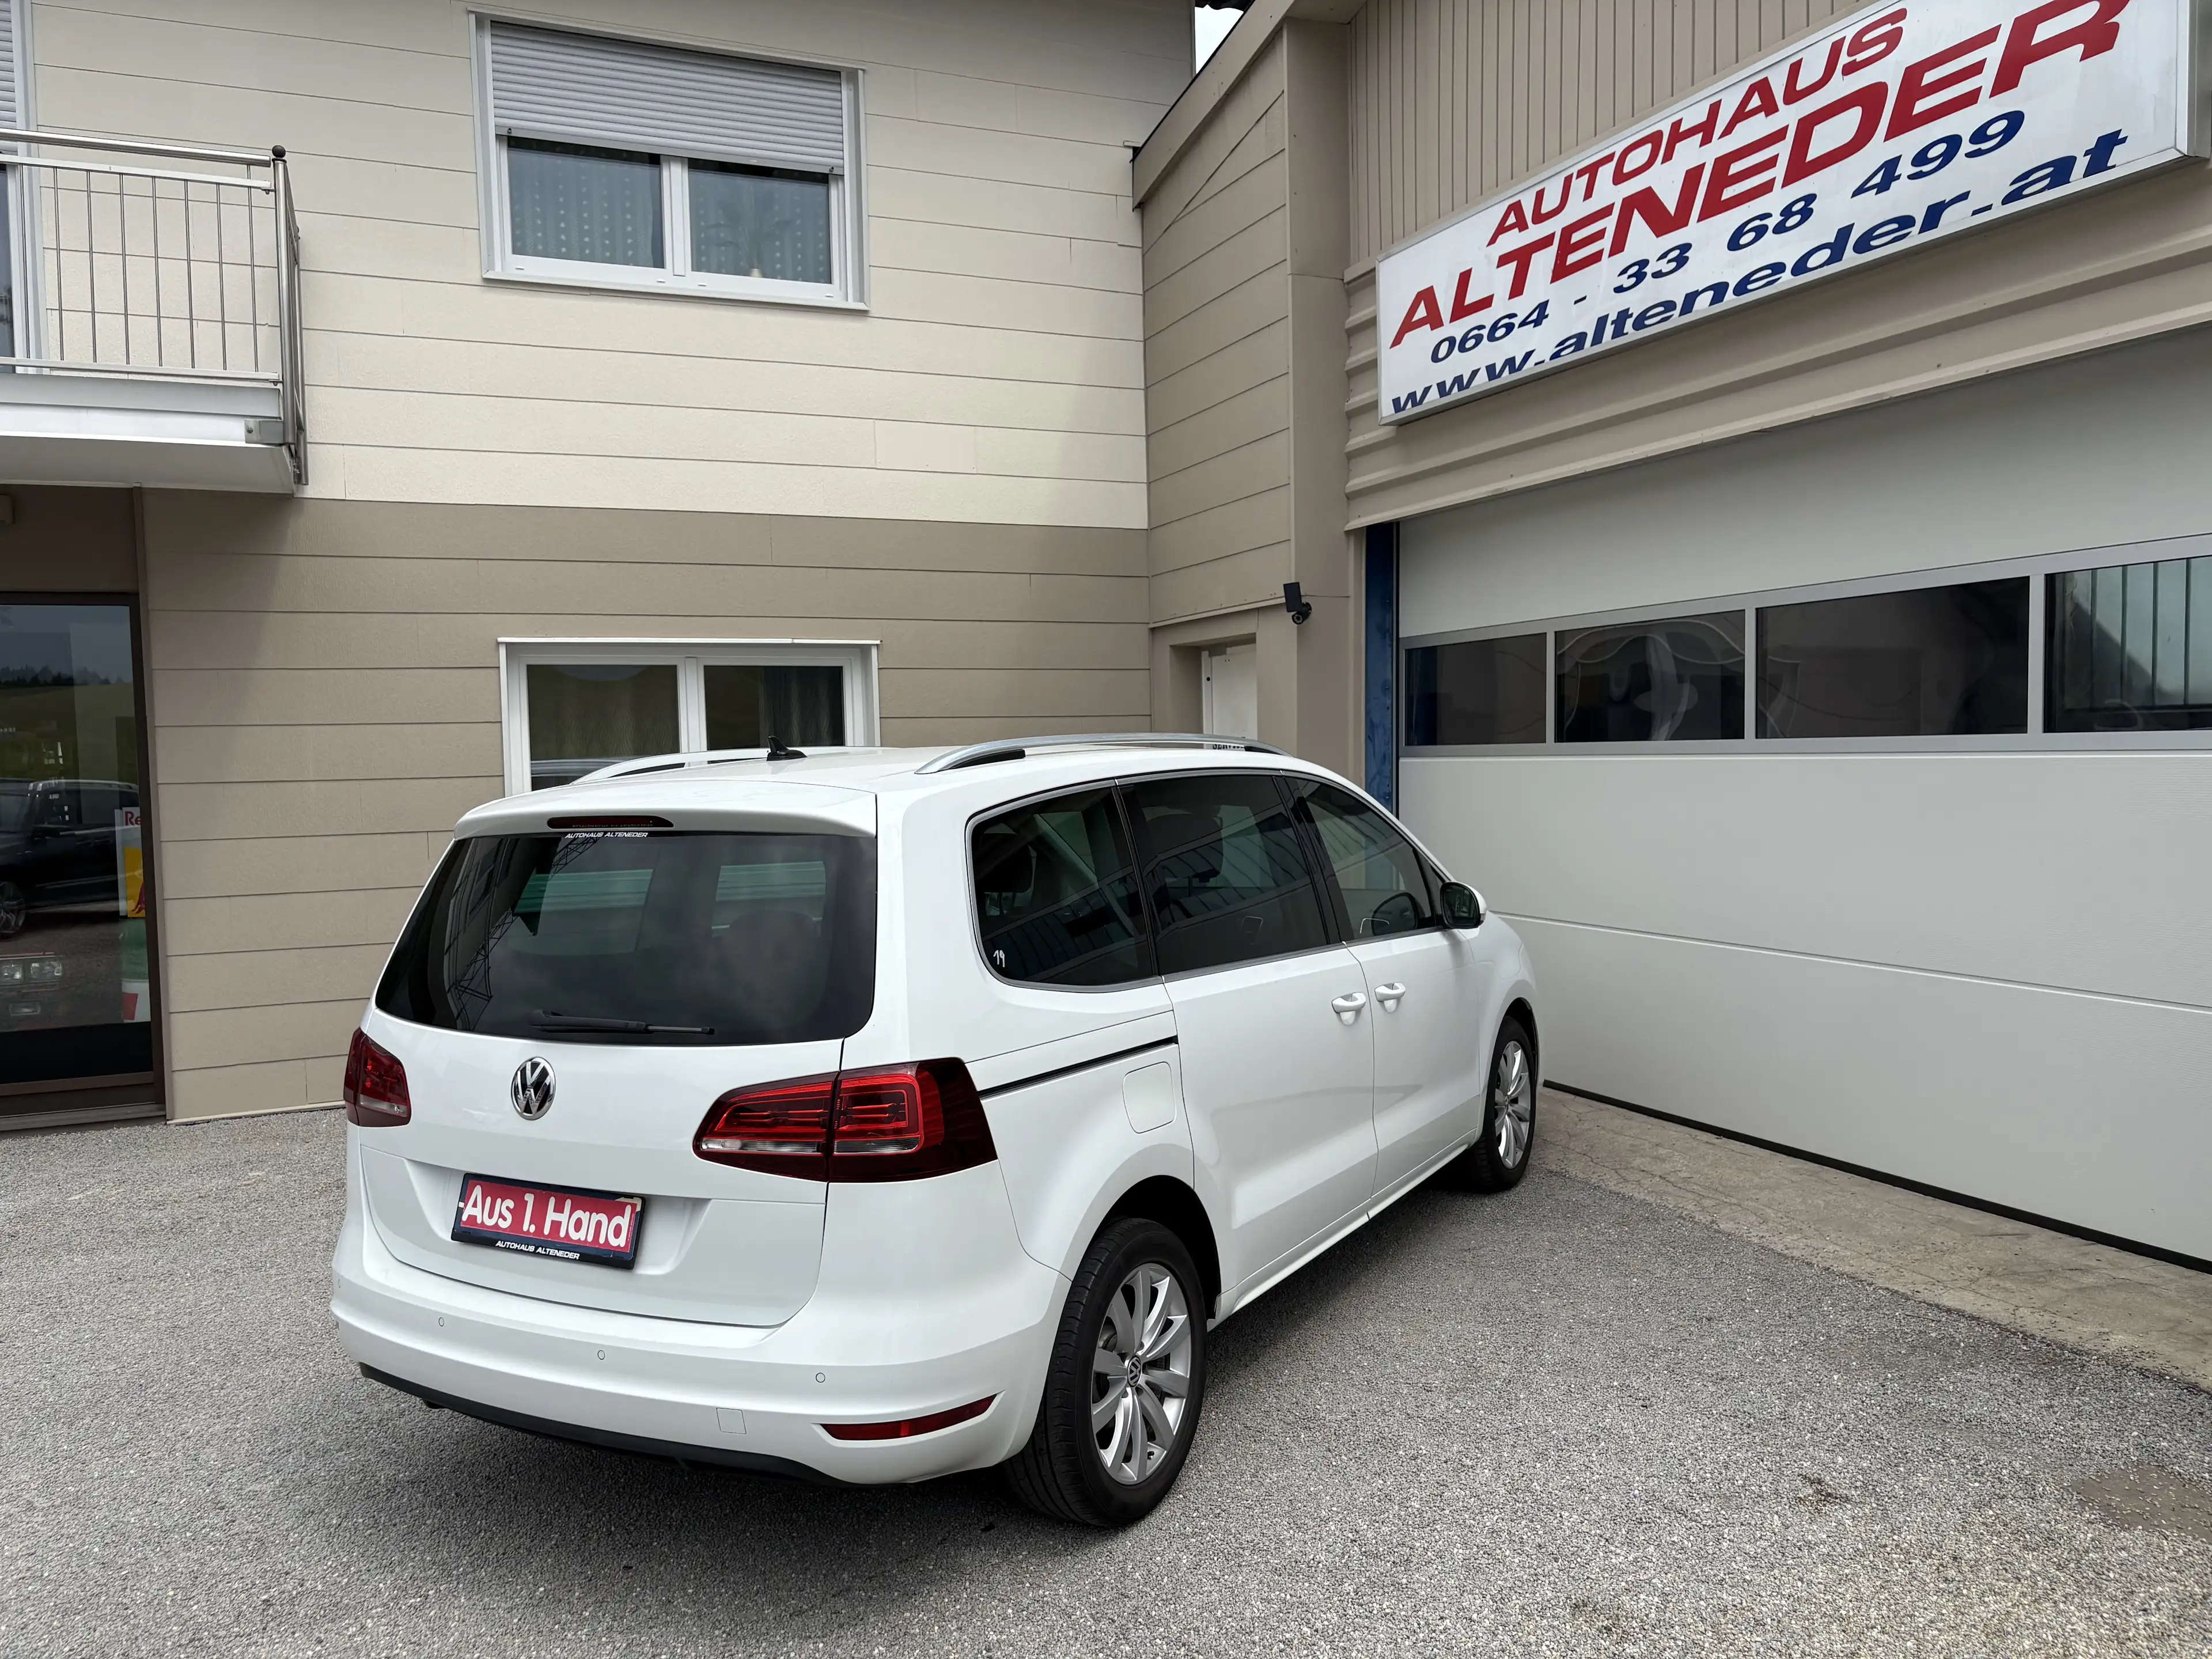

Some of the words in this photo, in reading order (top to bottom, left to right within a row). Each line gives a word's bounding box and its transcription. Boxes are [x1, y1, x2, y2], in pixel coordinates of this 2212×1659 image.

[1390, 0, 2130, 349] ALTENEDER
[1431, 299, 1550, 363] 0664
[1613, 242, 1692, 294] 33
[1726, 193, 1818, 252] 68
[1851, 109, 2025, 198] 499
[1487, 8, 1907, 246] AUTOHAUS
[1392, 128, 2129, 414] www.alteneder.at
[461, 1184, 515, 1229] Aus
[522, 1192, 536, 1233] 1.
[543, 1196, 632, 1248] Hand
[495, 1240, 535, 1252] AUTOHAUS
[536, 1247, 580, 1260] ALTENEDER
